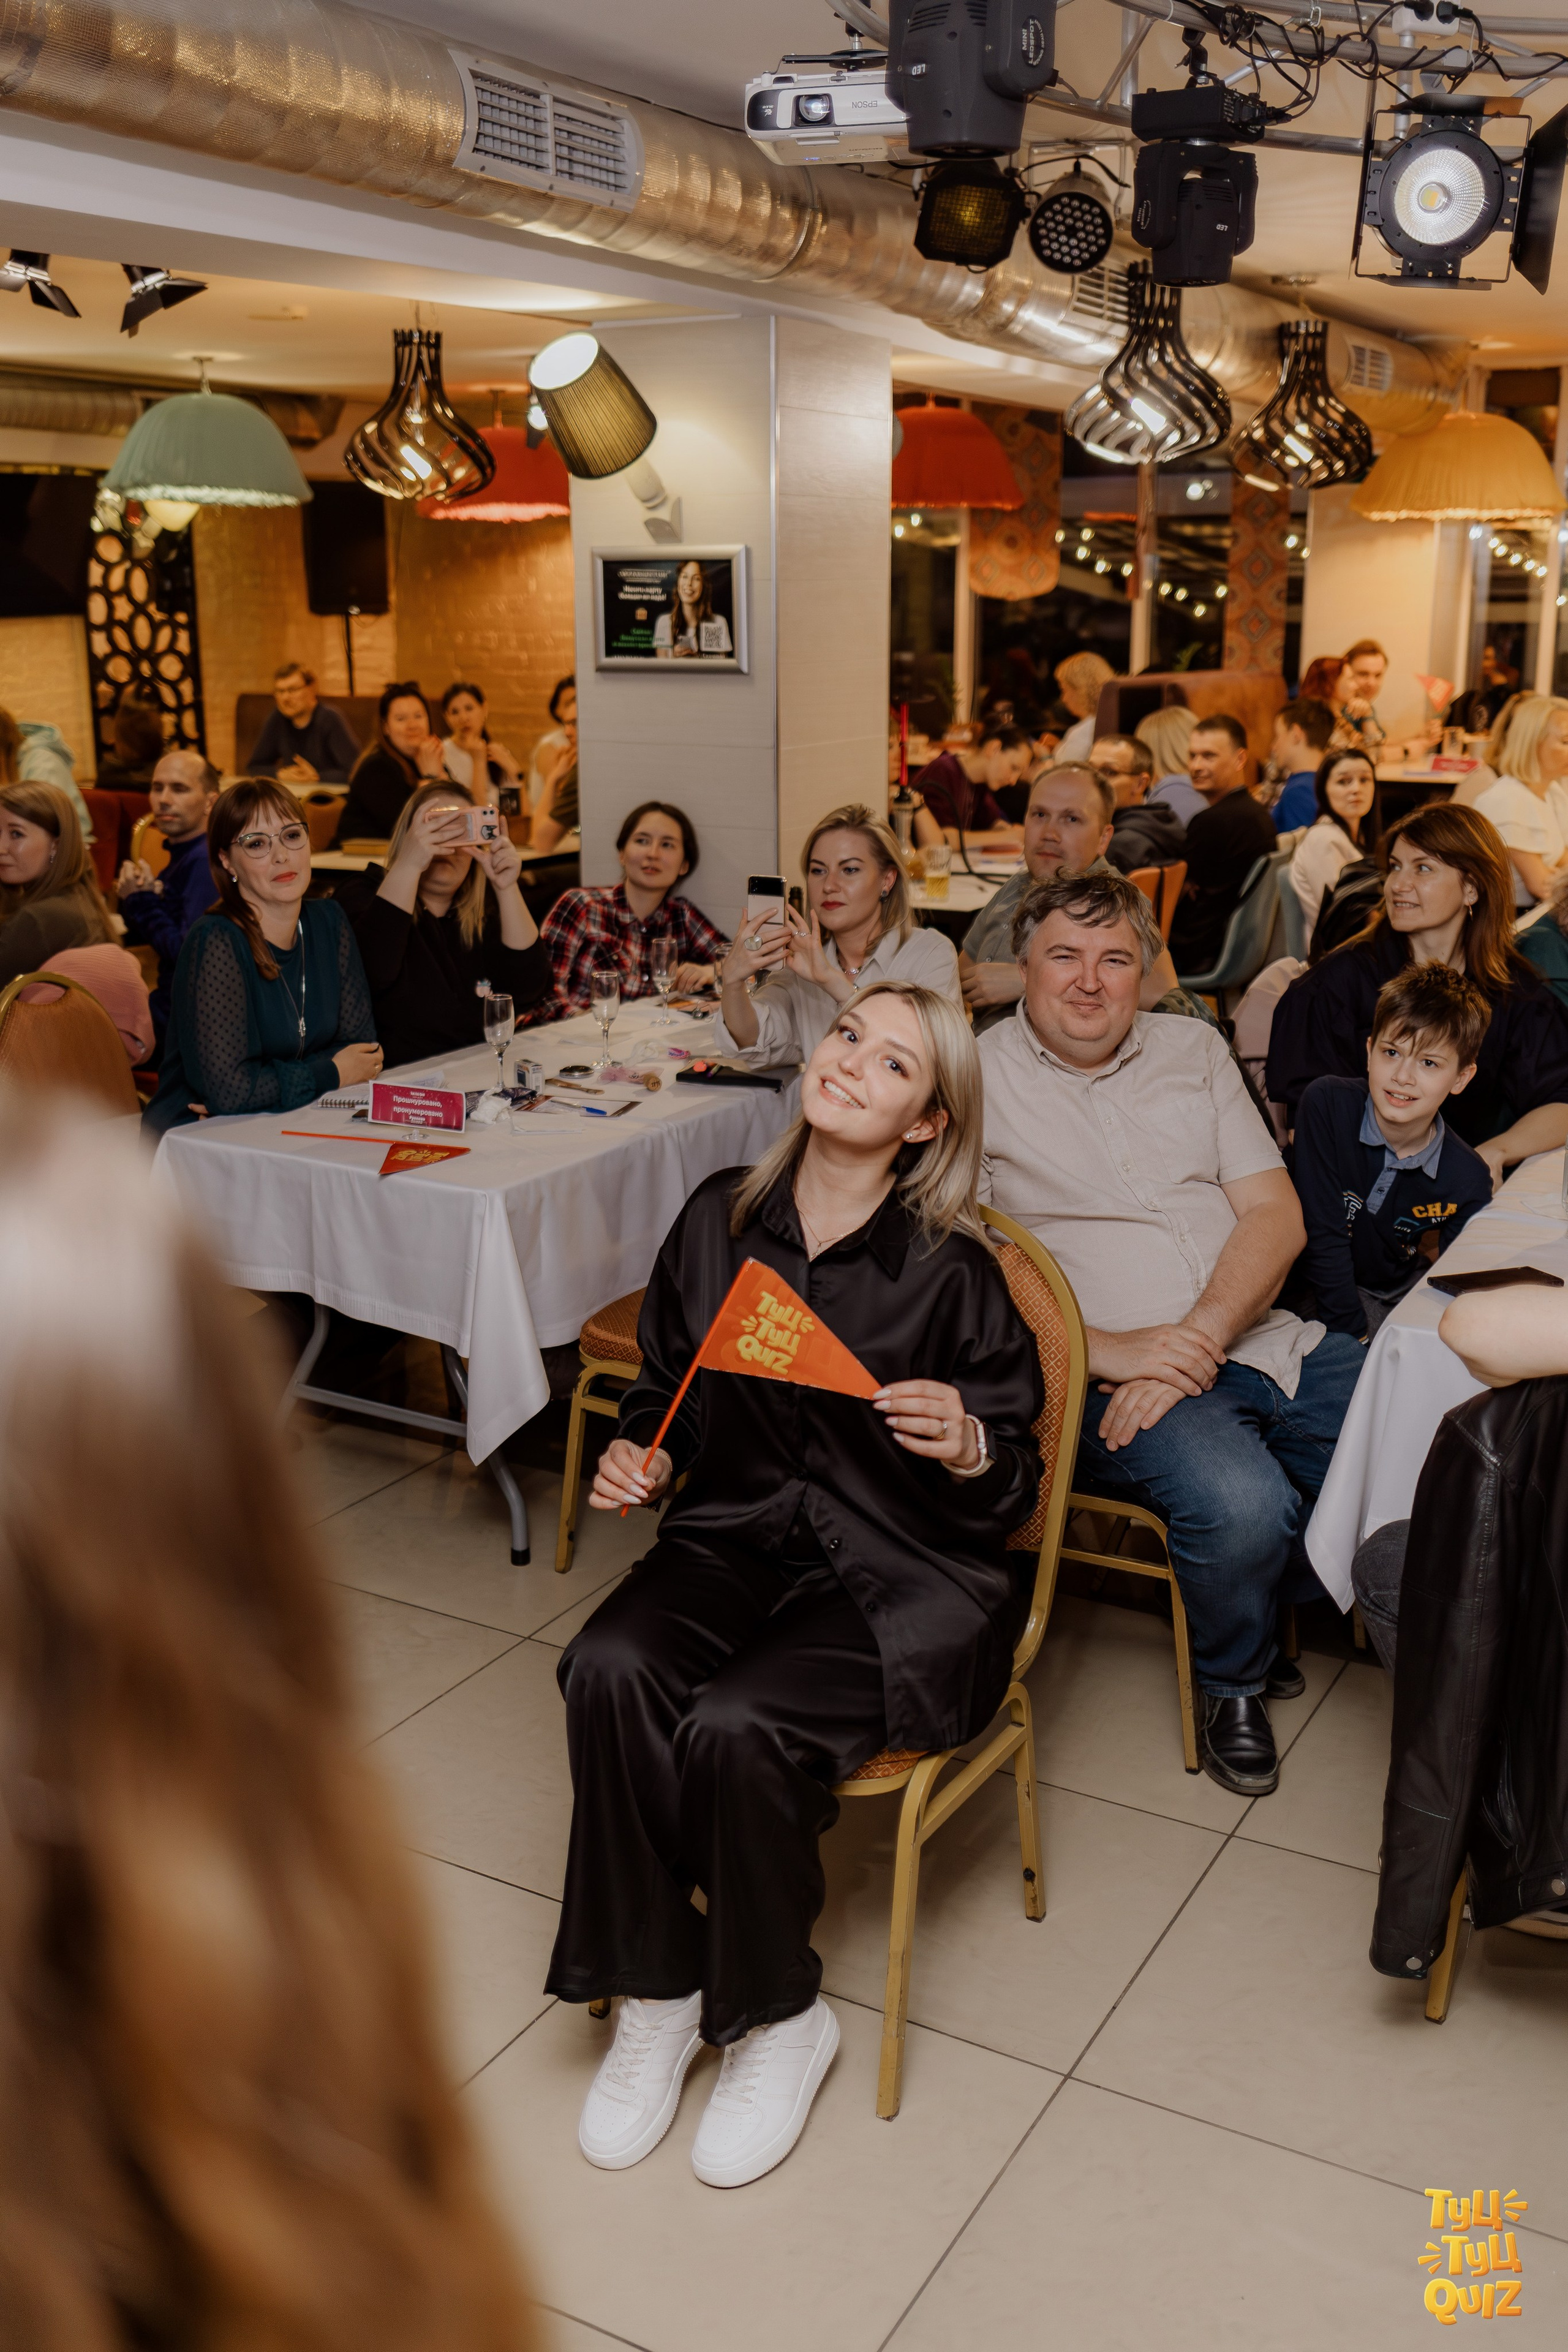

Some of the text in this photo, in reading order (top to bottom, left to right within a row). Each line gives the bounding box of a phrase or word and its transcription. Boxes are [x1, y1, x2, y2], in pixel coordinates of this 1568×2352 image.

[912, 64, 925, 75] LED
[851, 100, 878, 108] EPSON
[393, 1095, 442, 1108] Прошнуровано,
[393, 1106, 443, 1118] пронумеровано
